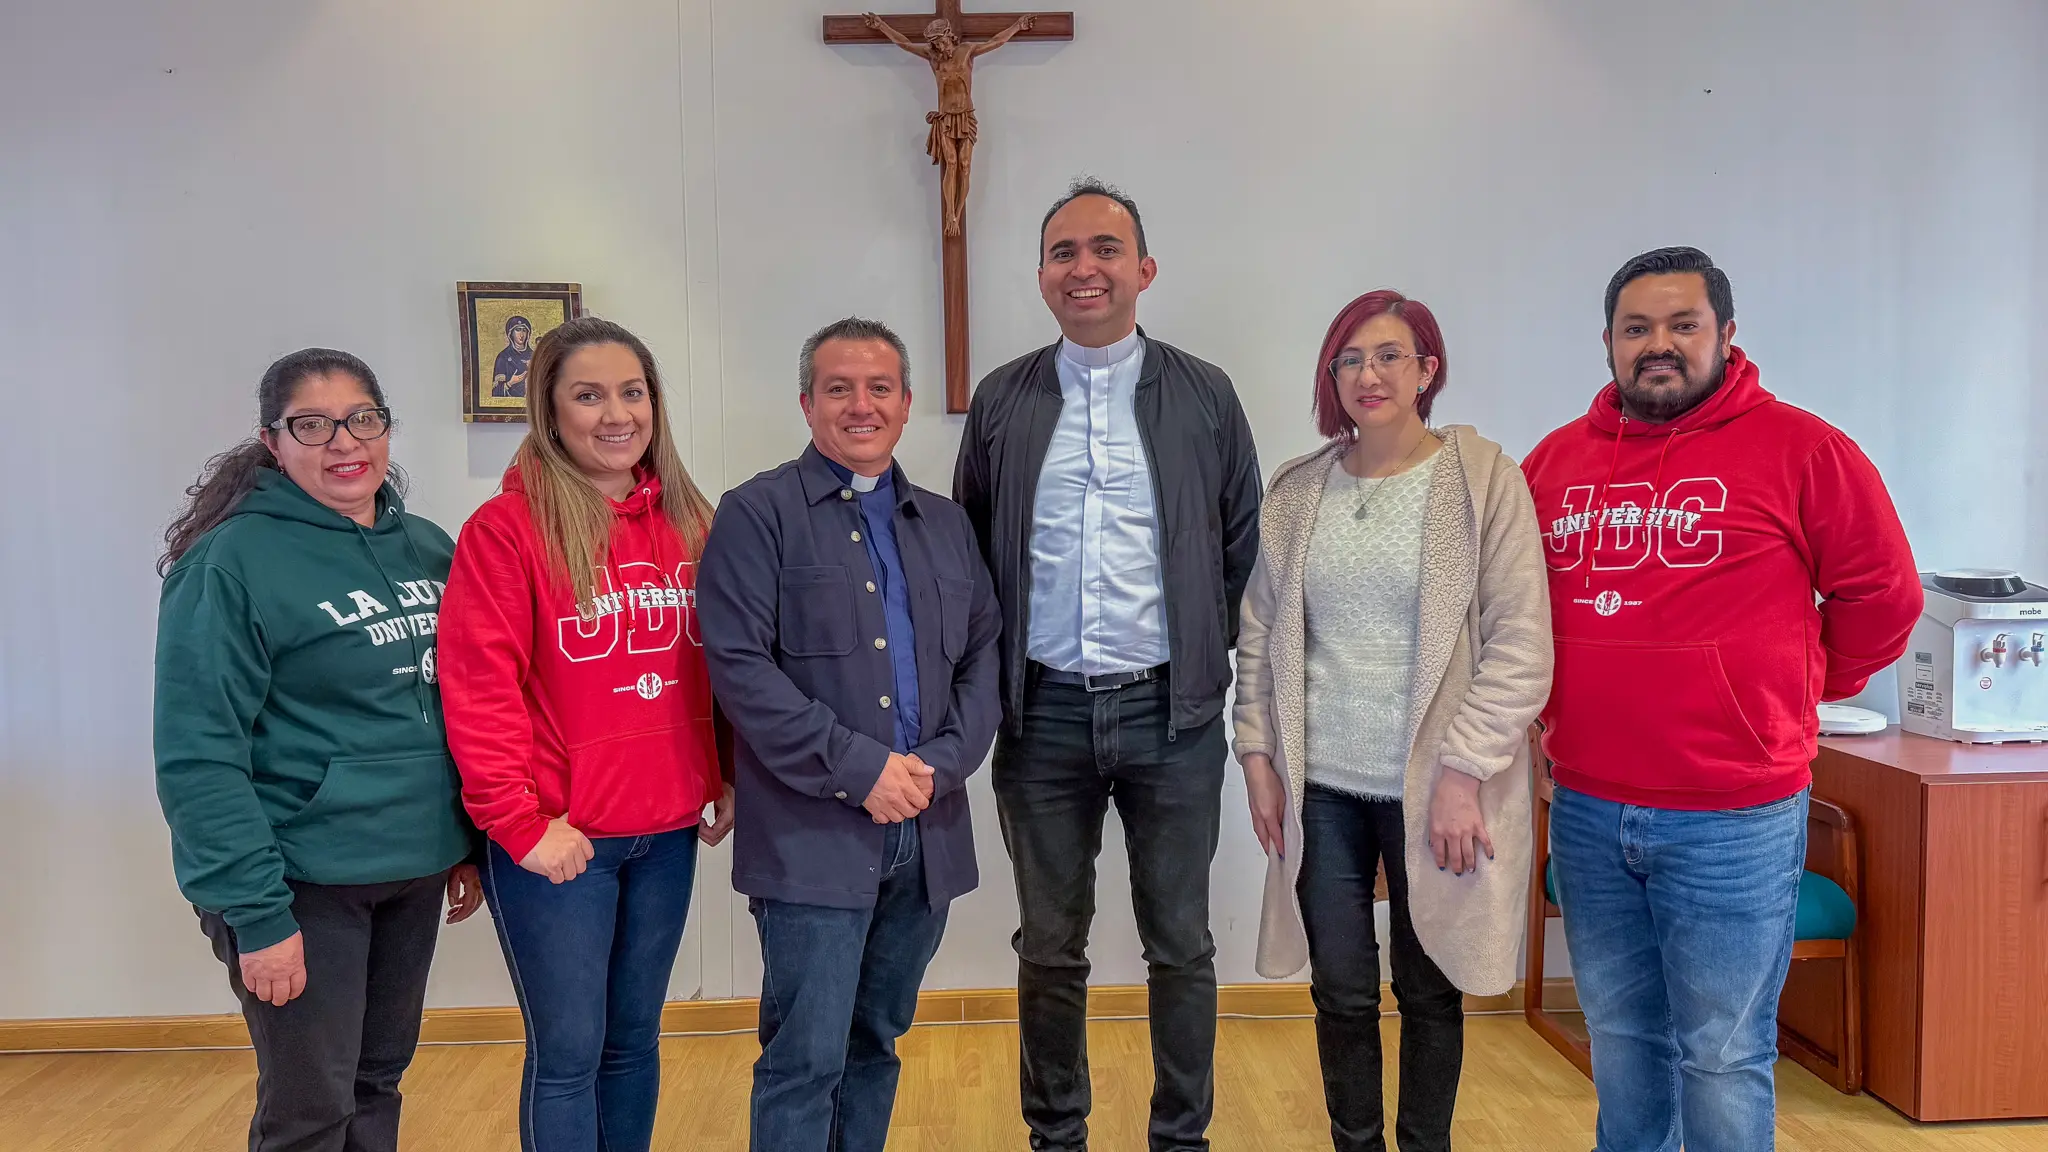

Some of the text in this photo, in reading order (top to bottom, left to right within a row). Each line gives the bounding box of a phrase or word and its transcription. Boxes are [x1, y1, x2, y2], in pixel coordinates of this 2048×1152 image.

[1541, 477, 1728, 572] JDC
[1552, 507, 1702, 538] UNIVERSITY
[317, 589, 389, 627] LA
[392, 665, 419, 675] SINCE
[612, 684, 636, 694] SINCE
